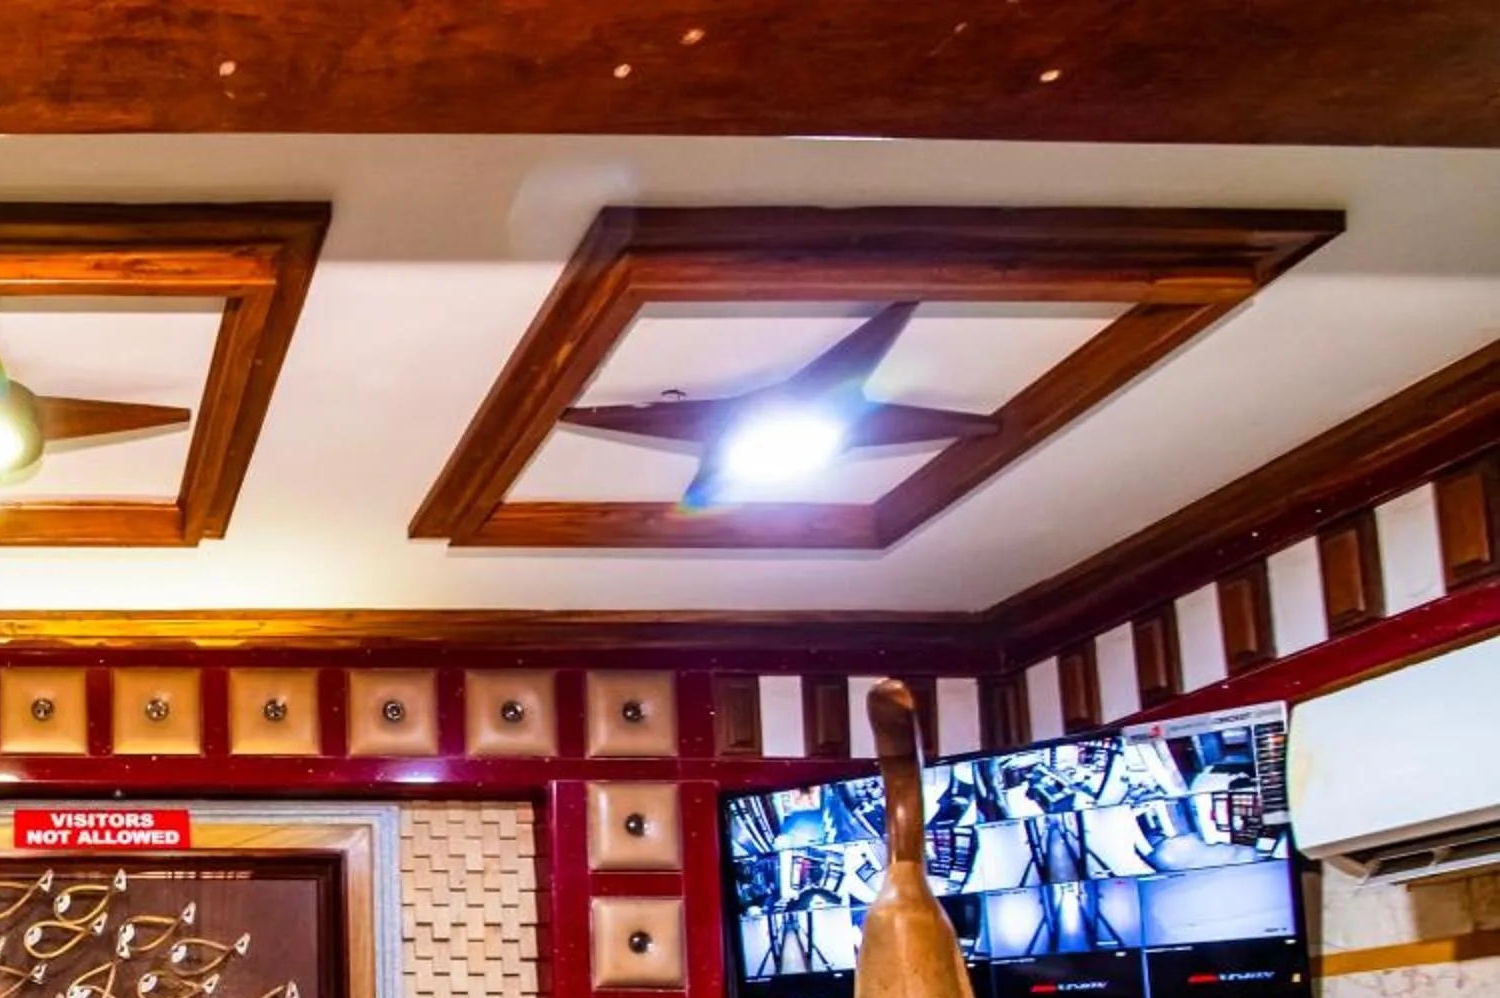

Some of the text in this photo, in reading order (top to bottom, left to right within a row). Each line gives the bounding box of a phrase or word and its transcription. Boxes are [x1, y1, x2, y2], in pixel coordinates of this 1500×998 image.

[51, 813, 155, 828] VISITORS
[26, 830, 180, 845] NOT ALLOWED
